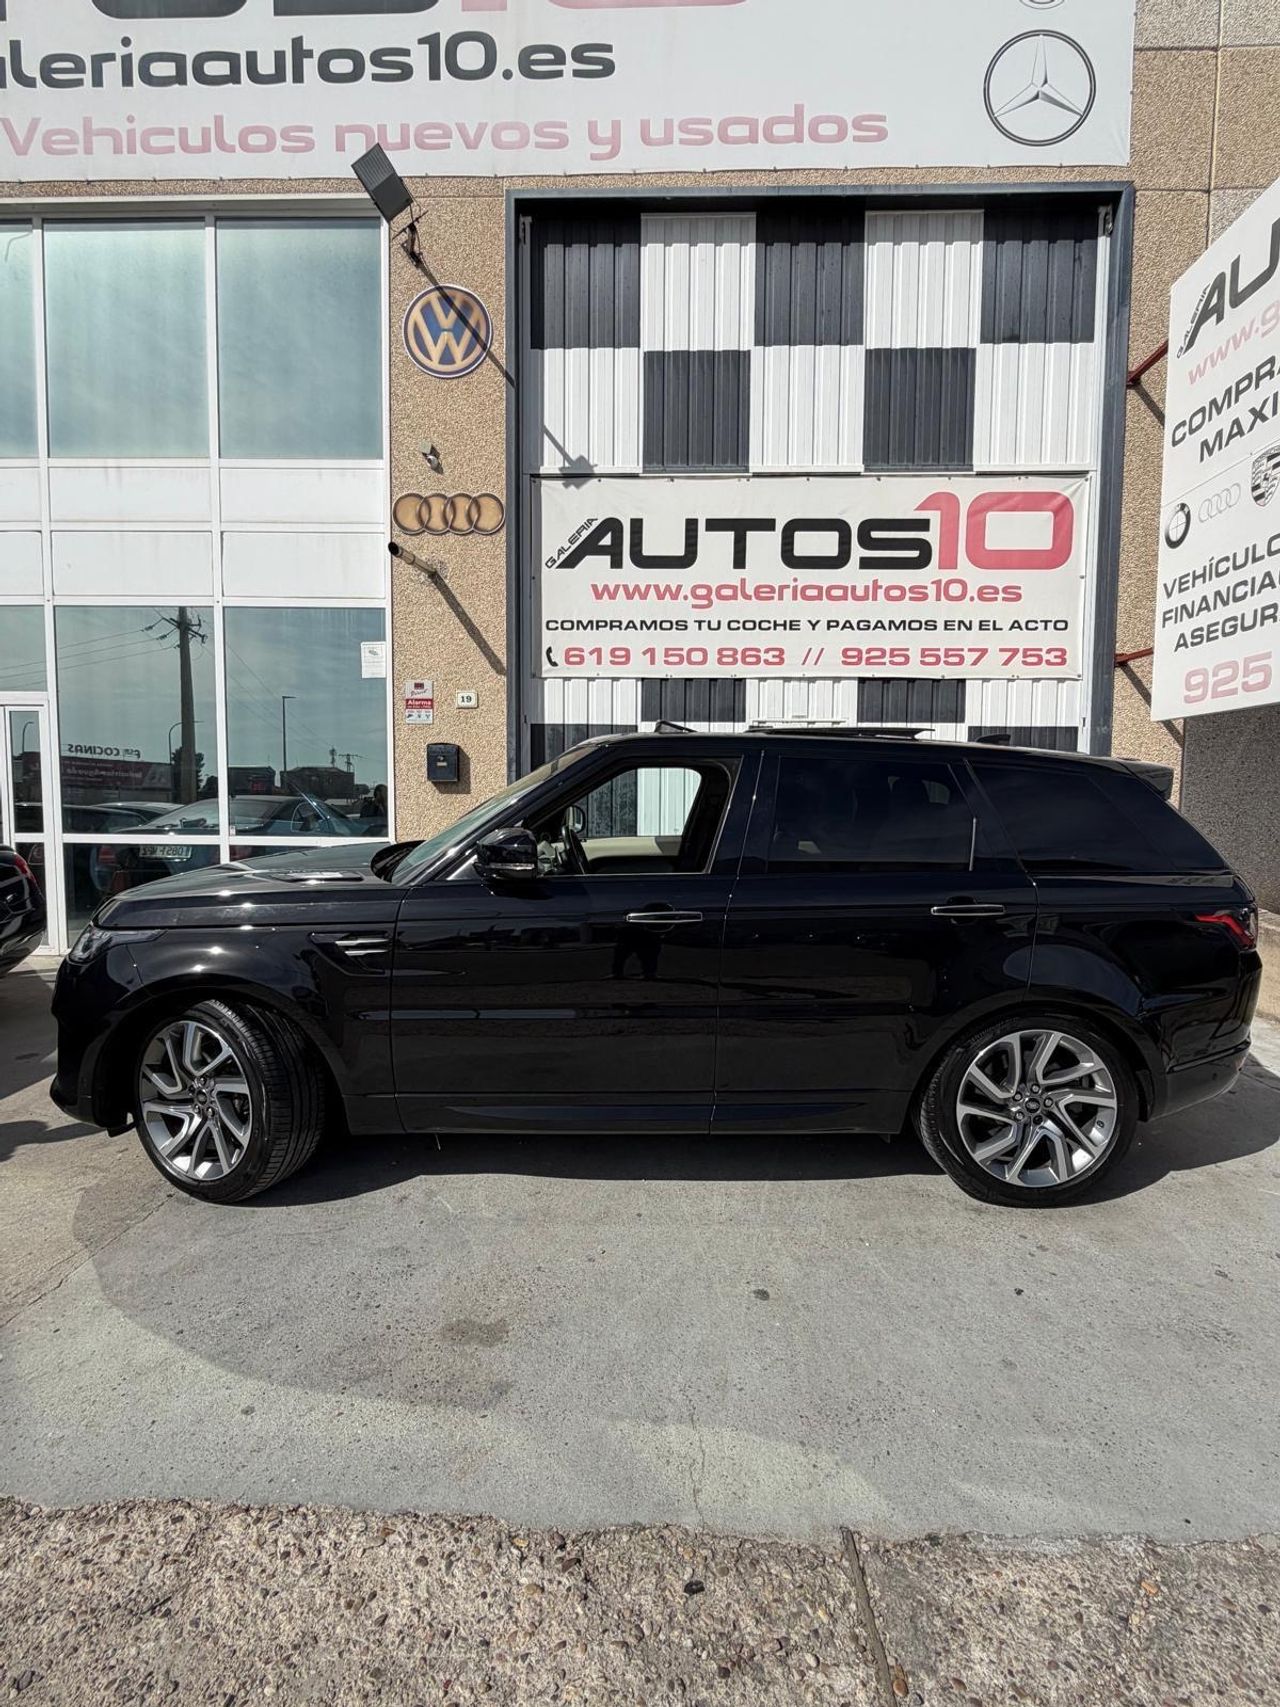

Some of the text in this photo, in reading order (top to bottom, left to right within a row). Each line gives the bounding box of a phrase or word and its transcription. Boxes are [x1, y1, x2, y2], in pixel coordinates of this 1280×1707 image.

[0, 30, 616, 89] leriaautos10.es
[1, 103, 889, 161] Vehiculos nuevos y usados
[1171, 355, 1280, 447] COMPR
[1199, 391, 1279, 463] MAXI
[544, 516, 599, 569] GALERIA
[555, 491, 1075, 570] AUTOS10
[590, 577, 1023, 609] www.galeriaautos10.es
[1162, 569, 1280, 629] FINANCIA
[545, 619, 1069, 632] COMPRAMOS TU COCHE Y PAGAMOS EN EL ACTO
[1174, 602, 1280, 653] ASEGUR
[564, 647, 631, 666] 619
[641, 647, 709, 666] 150
[716, 647, 786, 666] 863
[841, 647, 910, 667] 925
[919, 647, 989, 667] 557
[998, 647, 1068, 667] 753
[1183, 651, 1273, 705] 925
[460, 695, 472, 703] 19
